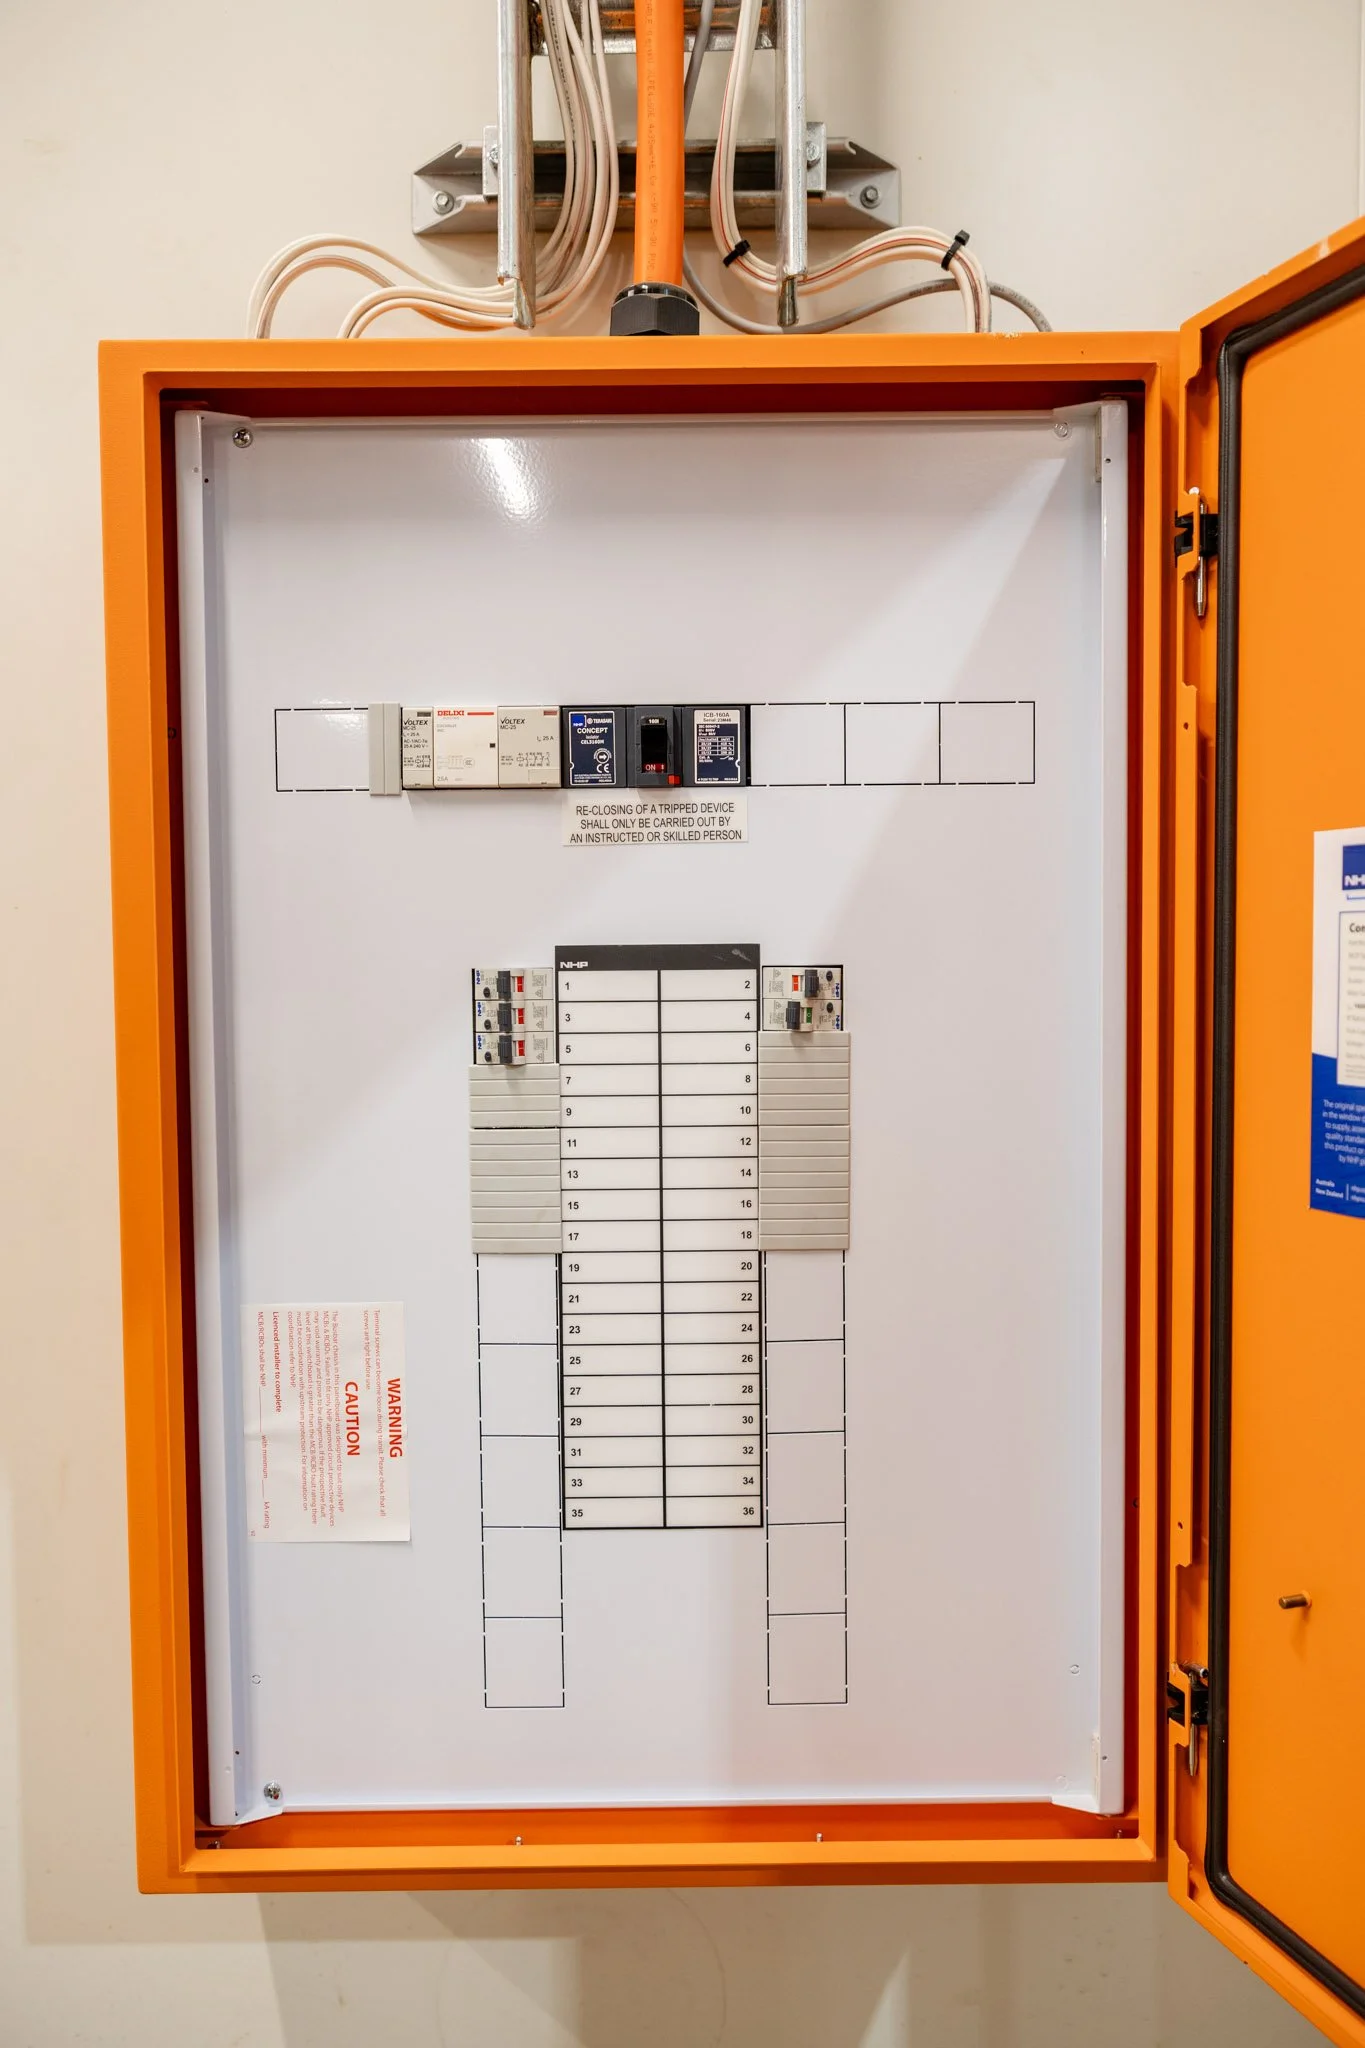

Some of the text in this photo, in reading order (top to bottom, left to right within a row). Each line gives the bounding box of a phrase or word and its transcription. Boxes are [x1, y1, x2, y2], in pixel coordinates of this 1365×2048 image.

[576, 802, 734, 816] RE-CLOSING OF A TRIPPED DEVICE
[580, 816, 731, 829] SHALL ONLY BE CARRIED OUT BY
[570, 830, 742, 843] AN INSTRUCTED OR SKILLED PERSON
[1344, 874, 1365, 887] NH
[564, 981, 570, 991] 1
[744, 980, 751, 989] 2
[564, 1013, 571, 1023] 3
[744, 1011, 751, 1021] 4
[565, 1044, 572, 1054] 5
[744, 1043, 751, 1052] 6
[565, 1076, 572, 1085] 7
[745, 1074, 751, 1084] 8
[565, 1107, 572, 1117] 9
[739, 1105, 752, 1115] 10
[566, 1138, 577, 1148] 11
[740, 1137, 752, 1146] 12
[567, 1169, 579, 1179] 13
[740, 1168, 752, 1177] 14
[567, 1201, 580, 1210] 15
[740, 1199, 753, 1208] 16
[567, 1232, 580, 1241] 17
[740, 1230, 753, 1240] 18
[568, 1263, 580, 1273] 19
[740, 1261, 753, 1271] 20
[568, 1294, 579, 1304] 21
[741, 1292, 753, 1302] 22
[568, 1325, 581, 1334] 23
[741, 1323, 753, 1332] 24
[569, 1356, 582, 1365] 25
[741, 1354, 754, 1363] 26
[274, 1371, 281, 1380] to
[569, 1386, 582, 1396] 27
[741, 1384, 754, 1394] 28
[274, 1380, 282, 1412] complete
[344, 1381, 360, 1456] CAUTION
[387, 1378, 403, 1458] WARNING
[570, 1417, 582, 1426] 29
[742, 1415, 754, 1425] 30
[570, 1448, 582, 1457] 31
[742, 1446, 754, 1455] 32
[571, 1478, 583, 1488] 33
[742, 1476, 754, 1485] 34
[571, 1508, 584, 1518] 35
[742, 1506, 755, 1516] 36
